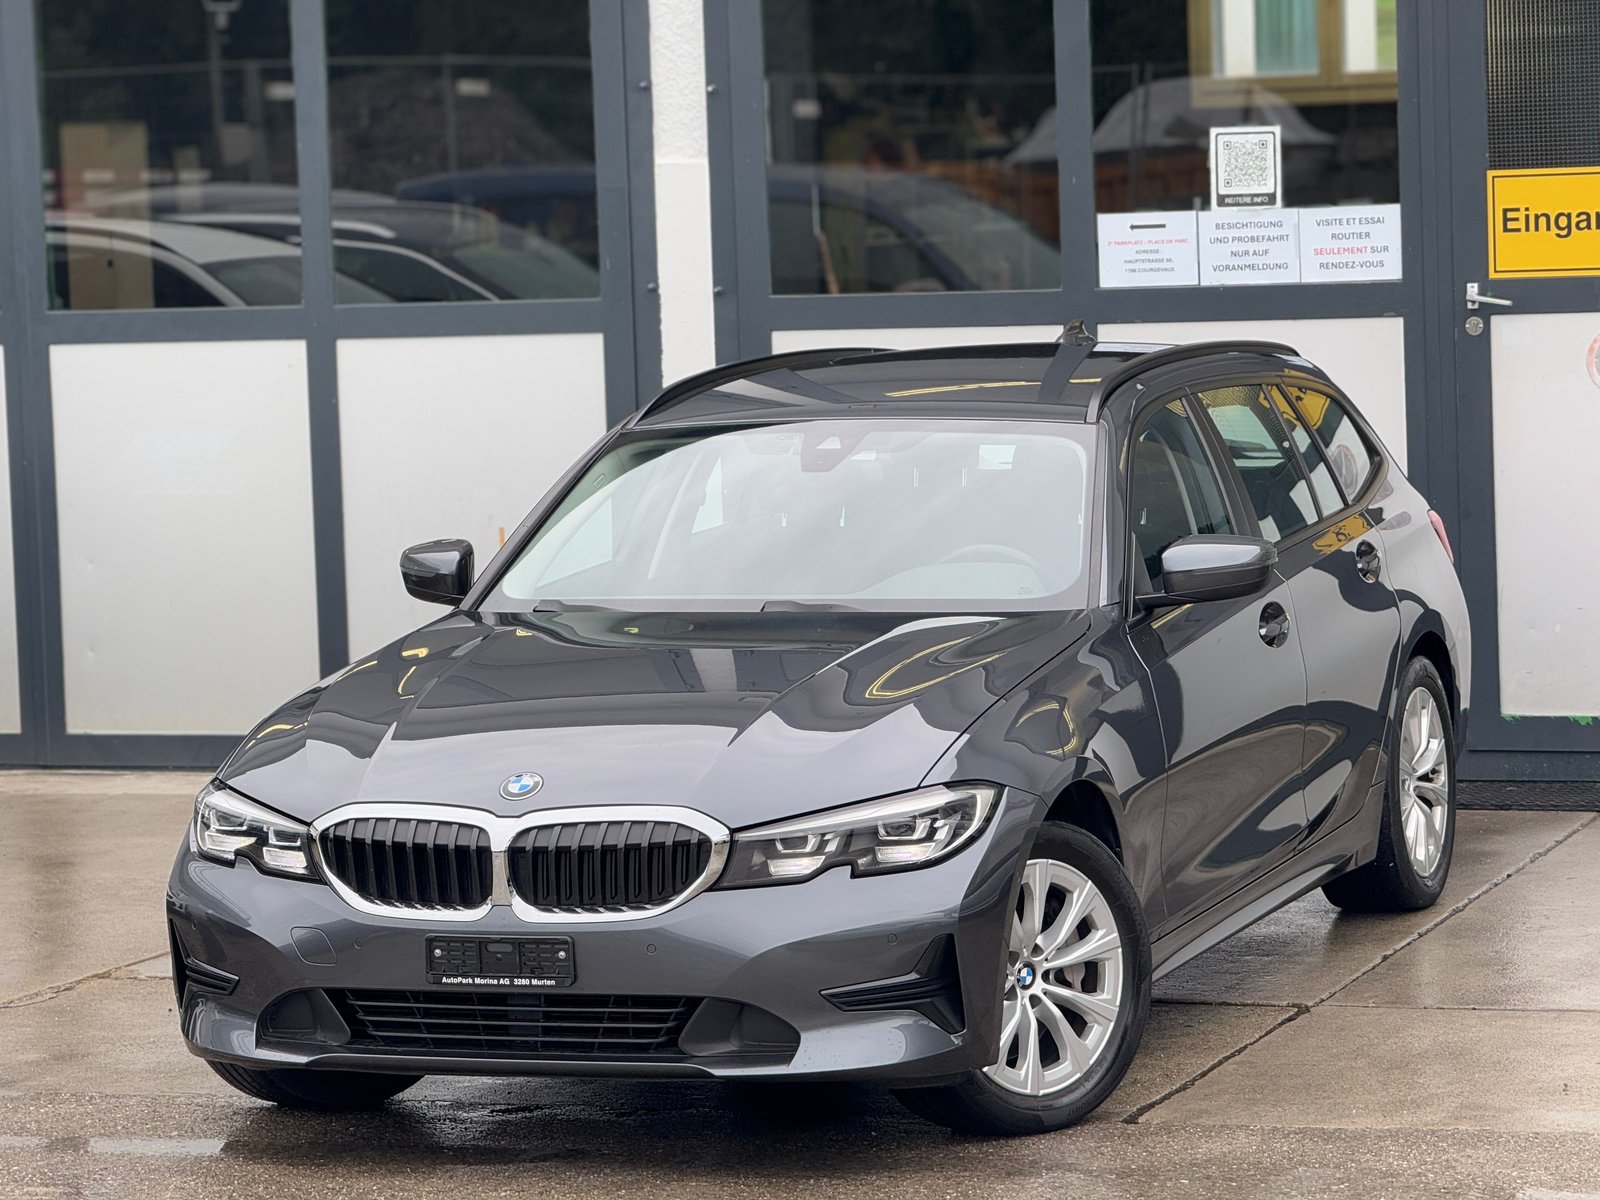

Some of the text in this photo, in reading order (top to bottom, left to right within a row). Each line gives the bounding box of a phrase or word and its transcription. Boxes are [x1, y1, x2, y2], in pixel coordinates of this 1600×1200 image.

[1215, 220, 1283, 230] BESICHTIGUNG
[1315, 217, 1385, 227] VISITE ET ESSAI
[1209, 234, 1290, 244] UND PROBEFAHRT
[1331, 232, 1371, 240] ROUTIER
[1230, 249, 1269, 258] NUR AUF
[1313, 246, 1368, 256] SEULEMENT
[1212, 262, 1289, 272] VORANMELDUNG
[1319, 260, 1385, 270] RENDEZ-VOUS
